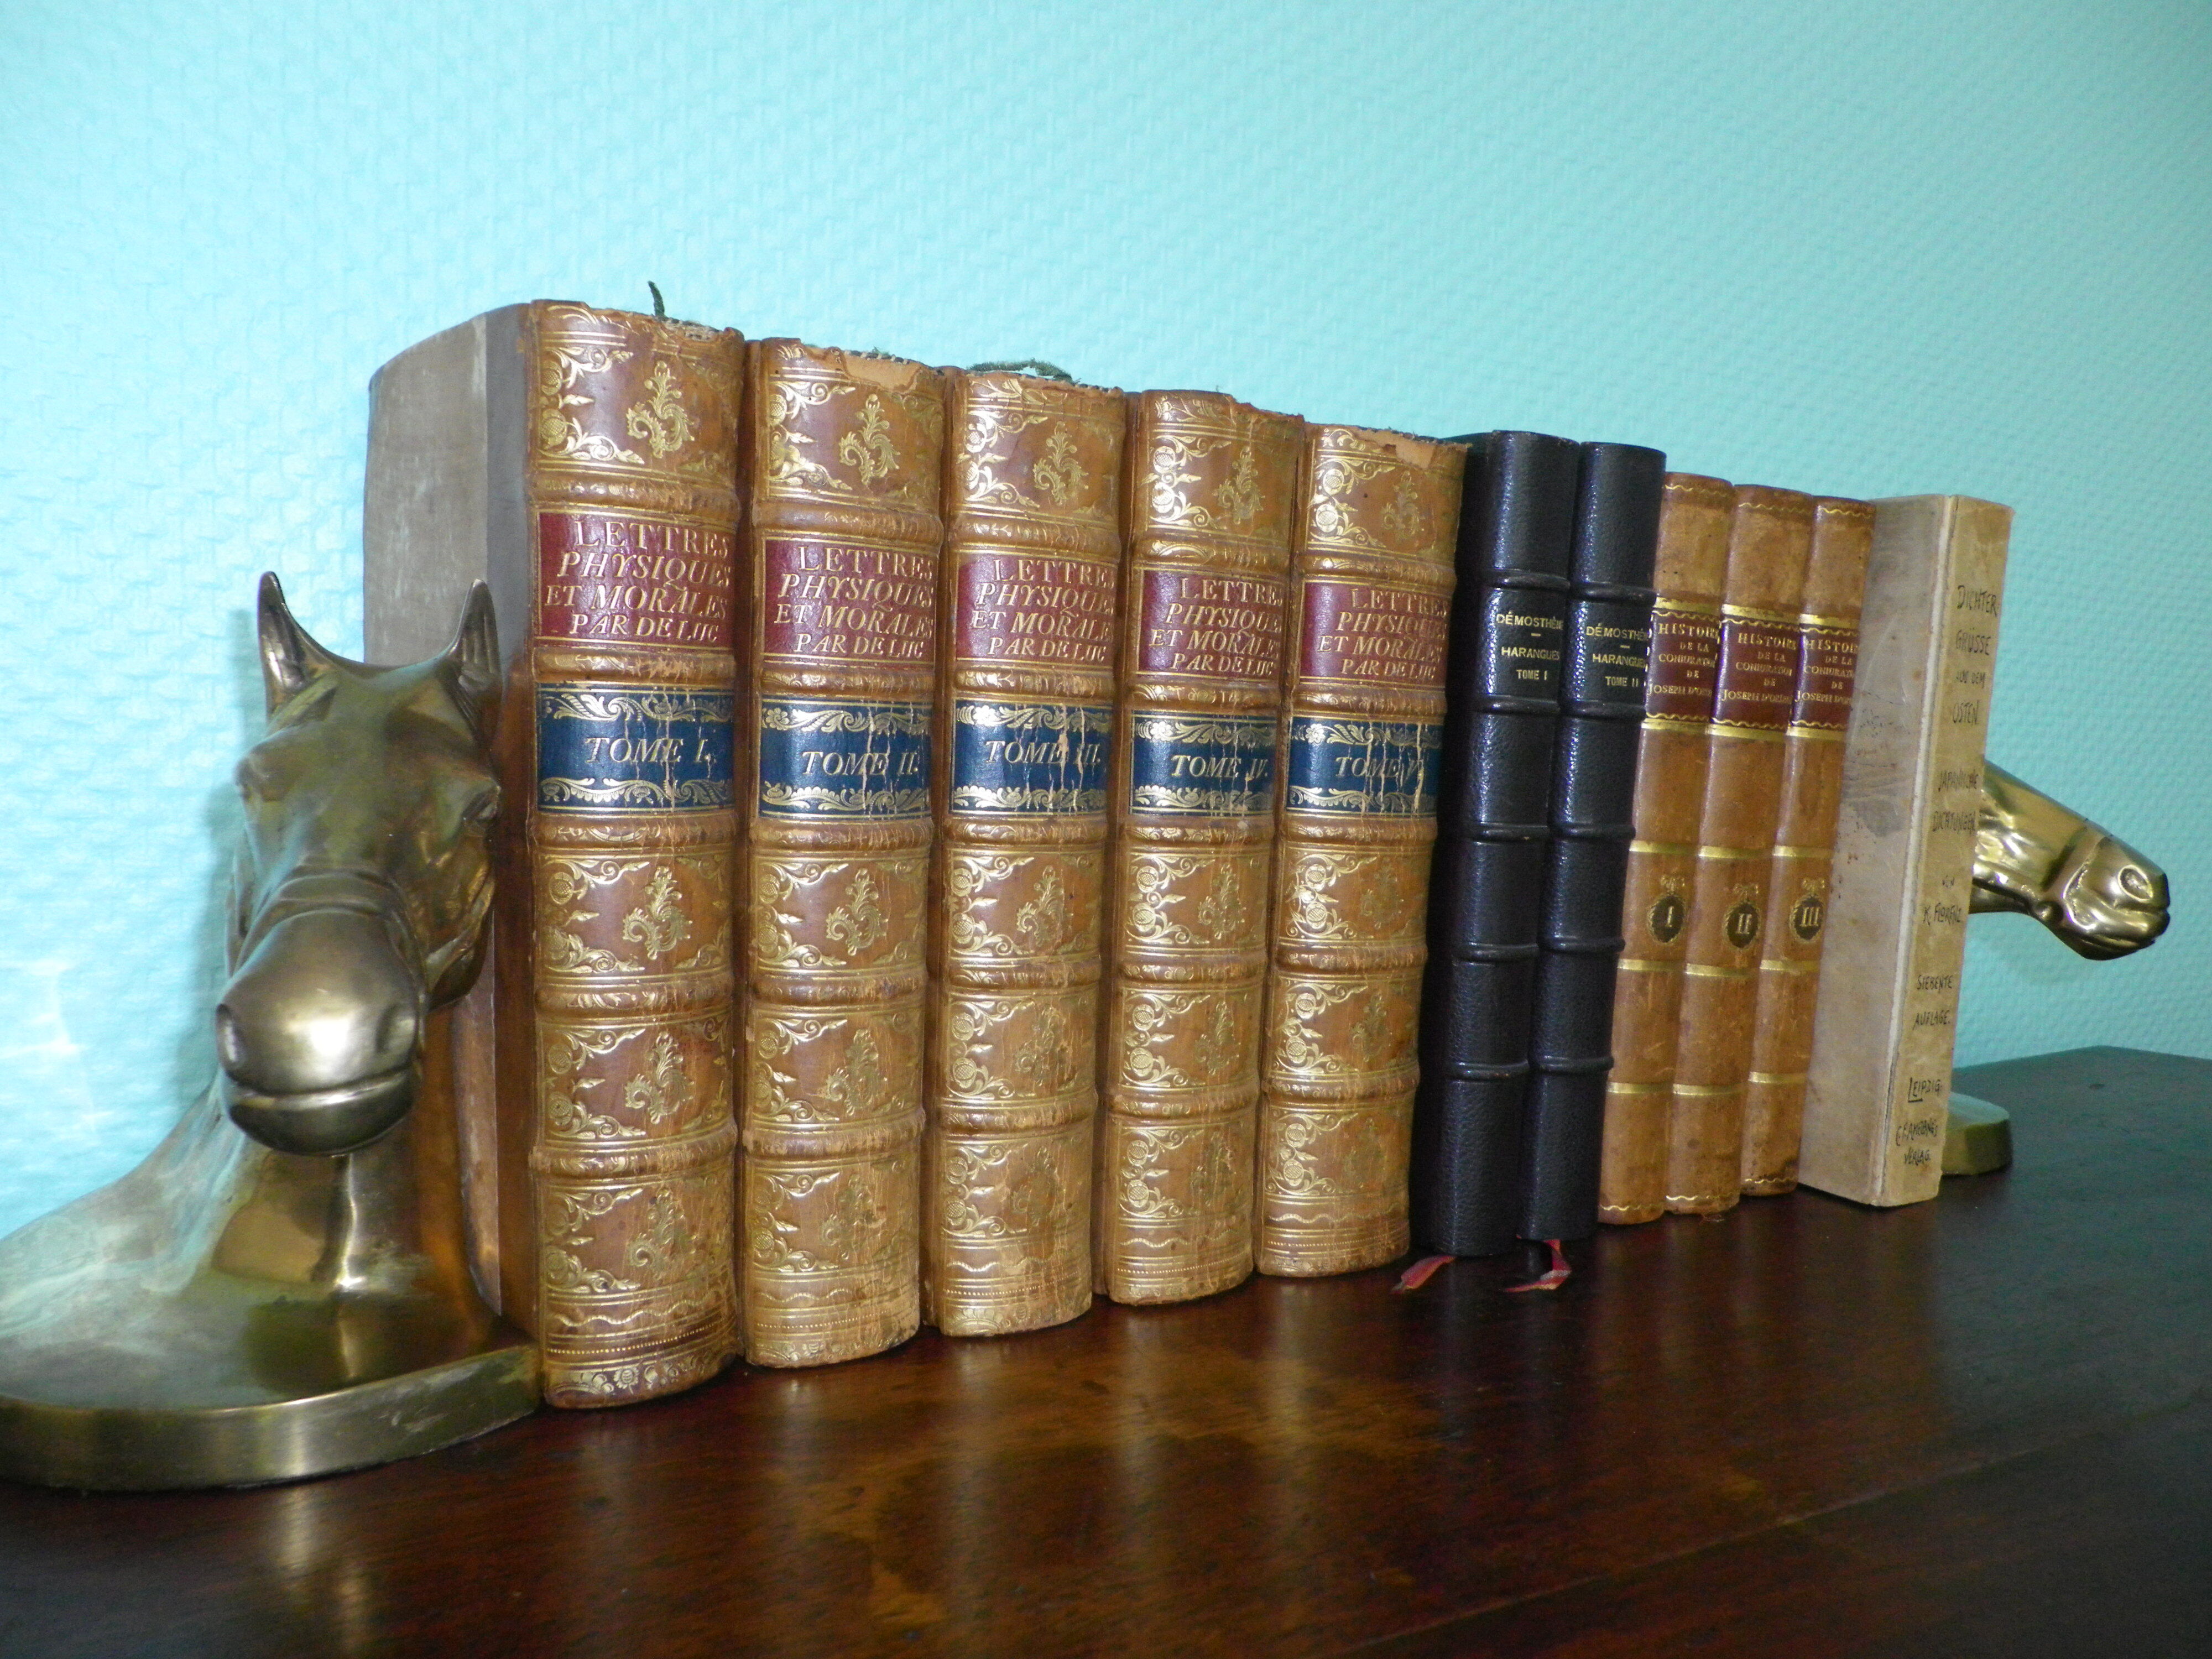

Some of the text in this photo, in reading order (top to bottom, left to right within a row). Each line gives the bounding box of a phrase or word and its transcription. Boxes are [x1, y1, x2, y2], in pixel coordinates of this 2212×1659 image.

[576, 520, 729, 559] LETTRES
[557, 552, 731, 592] PHYSIQUES
[798, 546, 933, 580] LETTRES
[994, 559, 1115, 589] LETTRES
[545, 585, 727, 619] ET MORALES
[778, 573, 934, 612] PHYSIQUES
[977, 583, 1115, 618] PHYSIQUES
[1957, 585, 1997, 617] DICHTER
[570, 614, 628, 636] PAR
[774, 604, 933, 640] ET MORALES
[972, 611, 1114, 641] ET MORALES
[794, 634, 846, 653] PAR
[988, 637, 1035, 656] PAR
[1149, 629, 1183, 646] ET
[1318, 635, 1348, 652] ET
[1680, 642, 1709, 652] DE LA
[1171, 653, 1213, 671] PAR
[1501, 646, 1560, 660] HARANGUES
[1775, 653, 1786, 662] LA
[1341, 659, 1379, 675] PAR
[1516, 670, 1547, 680] TOME I
[1687, 670, 1699, 678] DE
[1605, 676, 1638, 687] TOME II
[1646, 684, 1686, 695] JOSEPH
[1764, 678, 1775, 686] DE
[1721, 689, 1759, 701] JOSEPH
[1794, 691, 1832, 702] JOSEPH
[1953, 700, 1979, 726] OSTEN
[585, 737, 683, 763] TOME
[985, 740, 1063, 764] TOME
[802, 752, 889, 775] TOME
[1665, 906, 1672, 927] I
[1736, 914, 1752, 934] II
[1799, 907, 1819, 926] III
[1917, 974, 1953, 994] SIEBENTE
